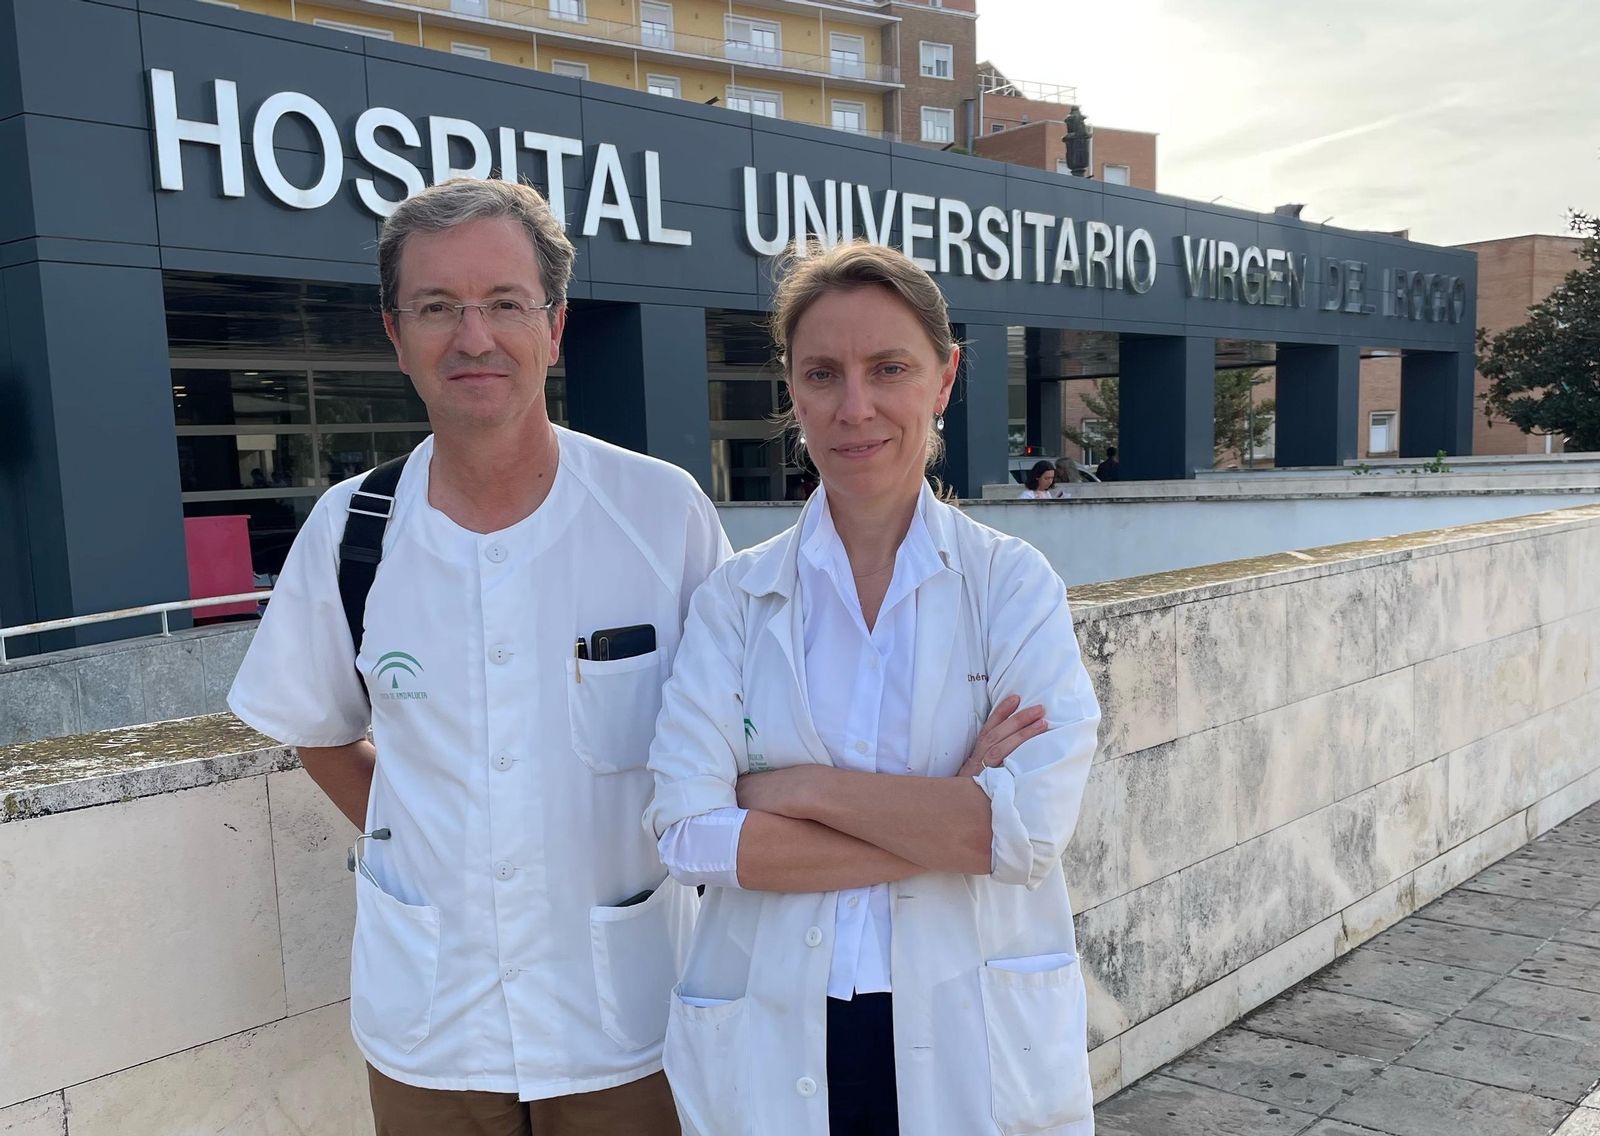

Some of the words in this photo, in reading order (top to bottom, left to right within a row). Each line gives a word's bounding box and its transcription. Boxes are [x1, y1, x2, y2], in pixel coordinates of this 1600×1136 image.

[149, 68, 692, 247] HOSPITAL
[743, 166, 1158, 296] UNIVERSITARIO
[1181, 235, 1307, 308] VIRGEN
[1321, 256, 1377, 314] DEL
